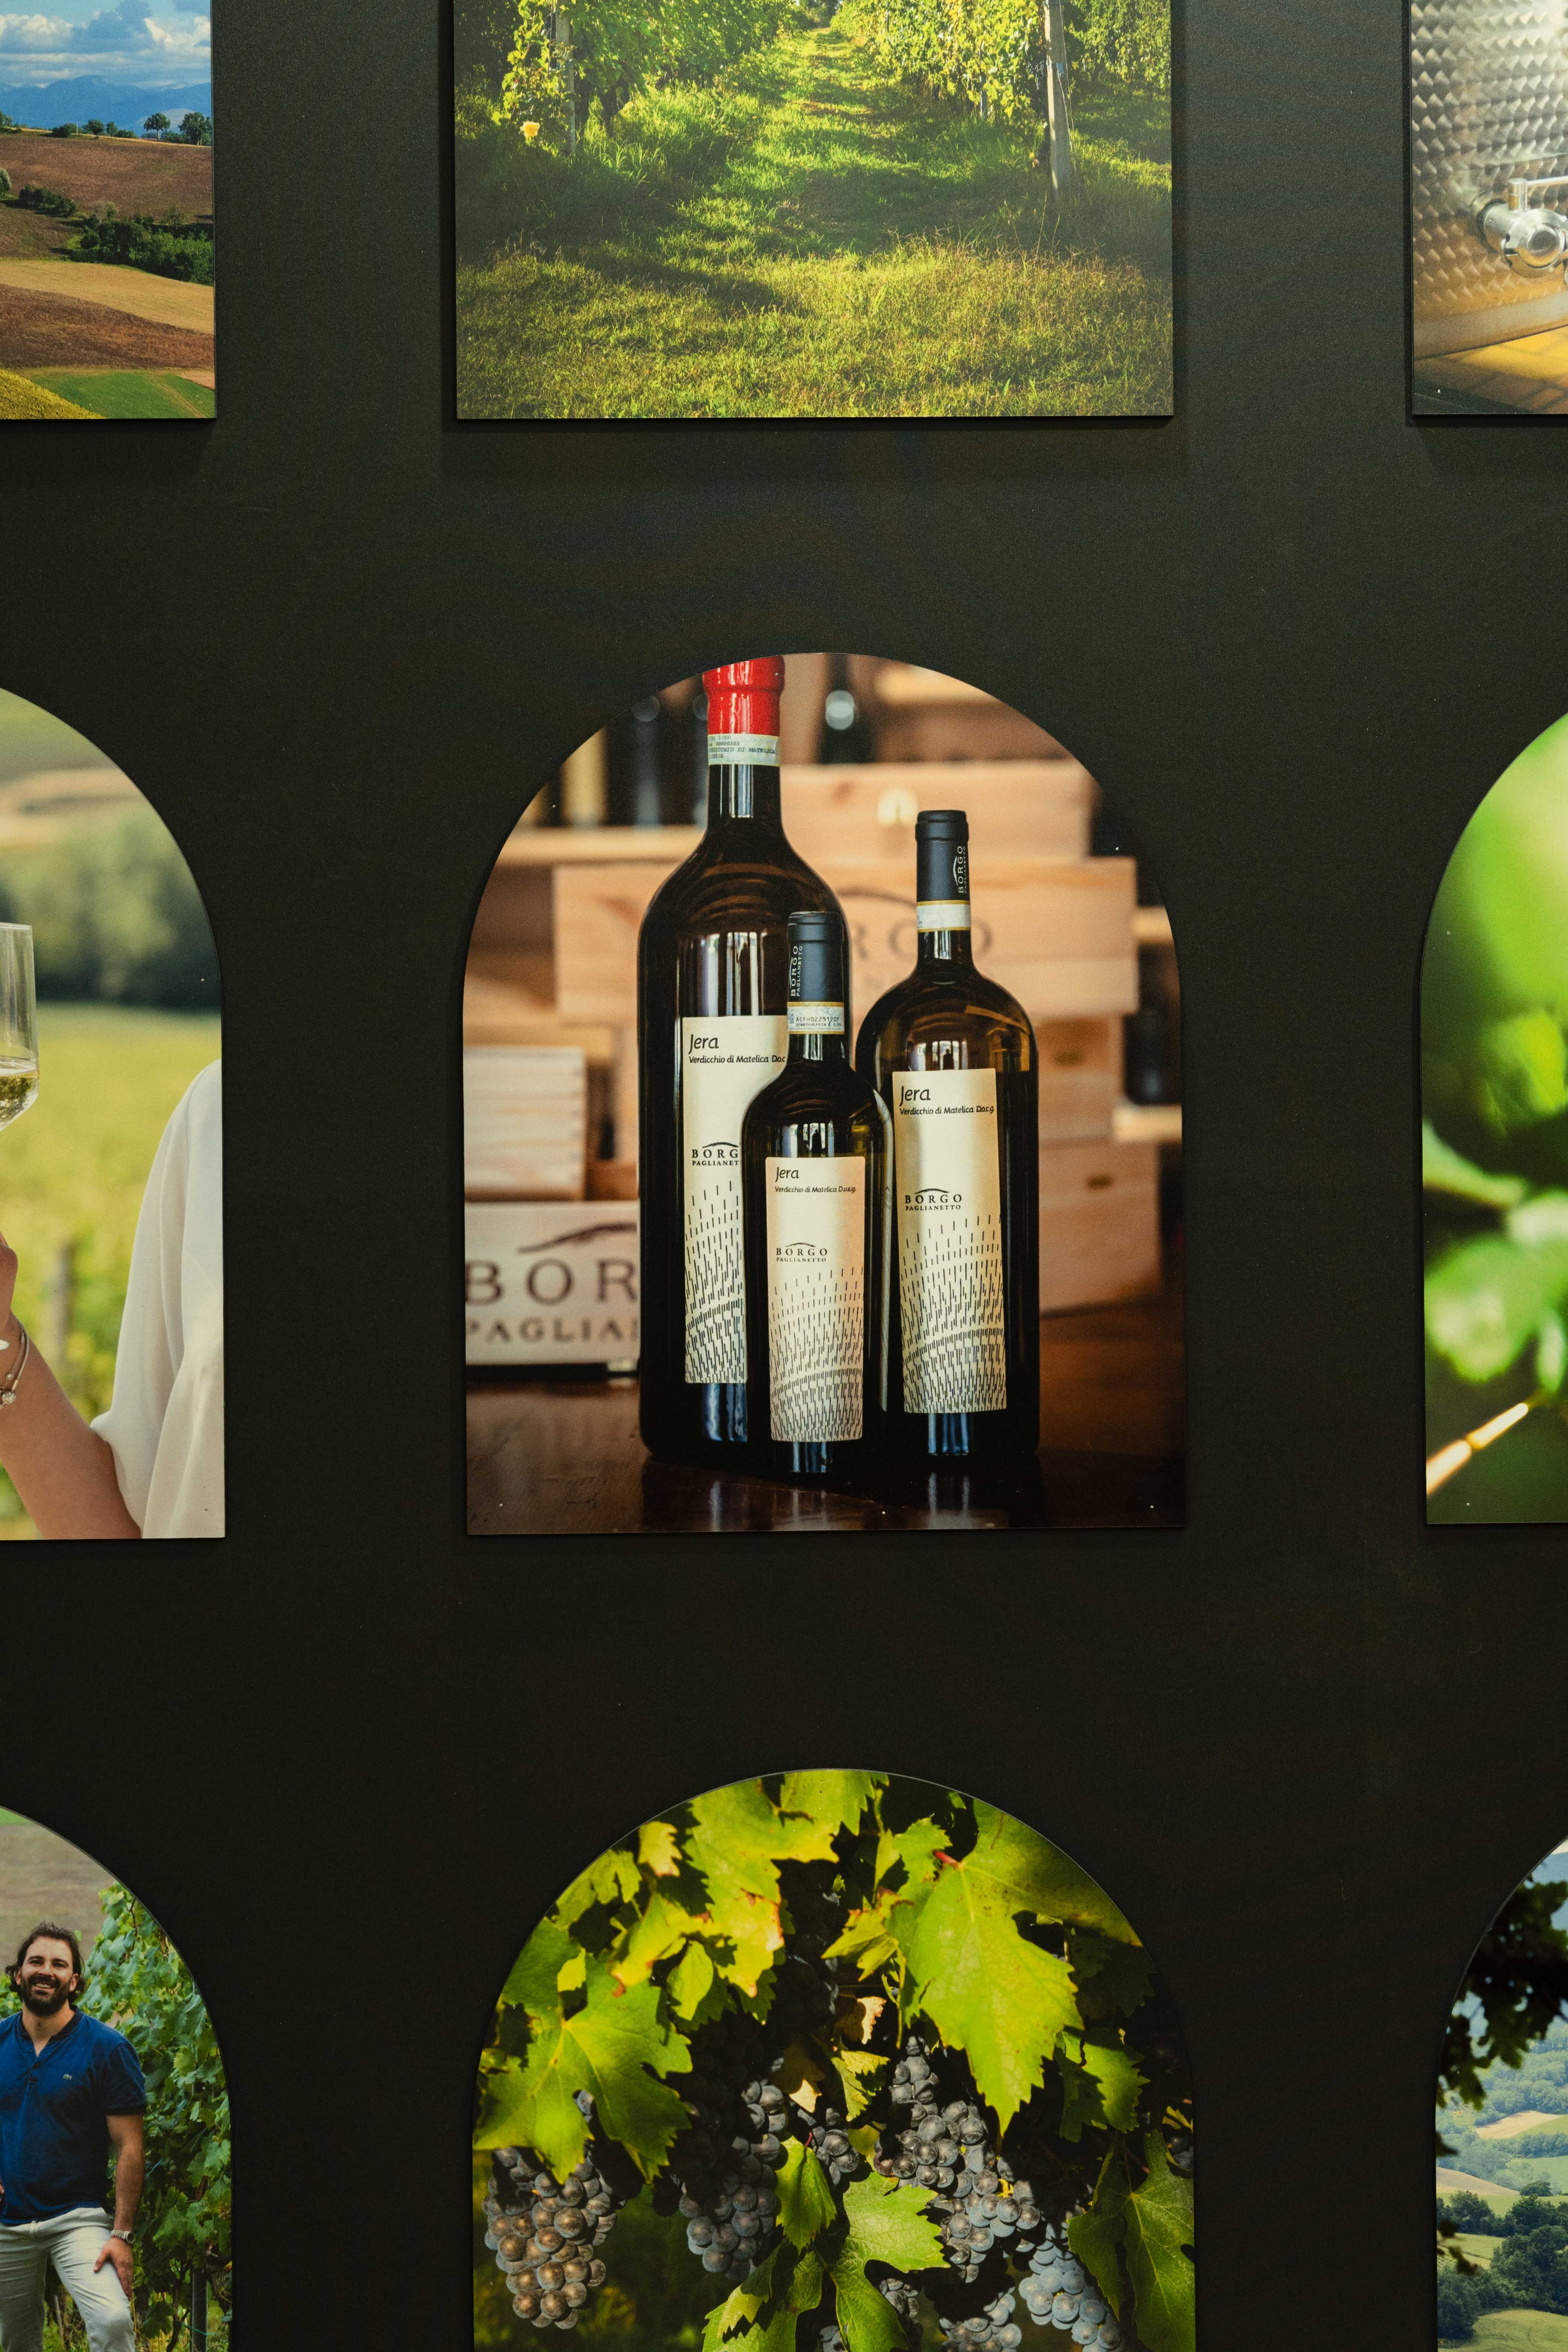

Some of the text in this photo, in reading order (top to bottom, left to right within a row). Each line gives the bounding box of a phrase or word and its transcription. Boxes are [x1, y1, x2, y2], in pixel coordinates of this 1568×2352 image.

[688, 1034, 719, 1055] Jera
[736, 1055, 769, 1063] Matelica
[899, 1086, 931, 1106] Jera
[692, 1149, 738, 1158] BORG
[775, 1166, 799, 1182] Jera
[905, 1194, 962, 1204] BORGO
[465, 1258, 637, 1306] BOR
